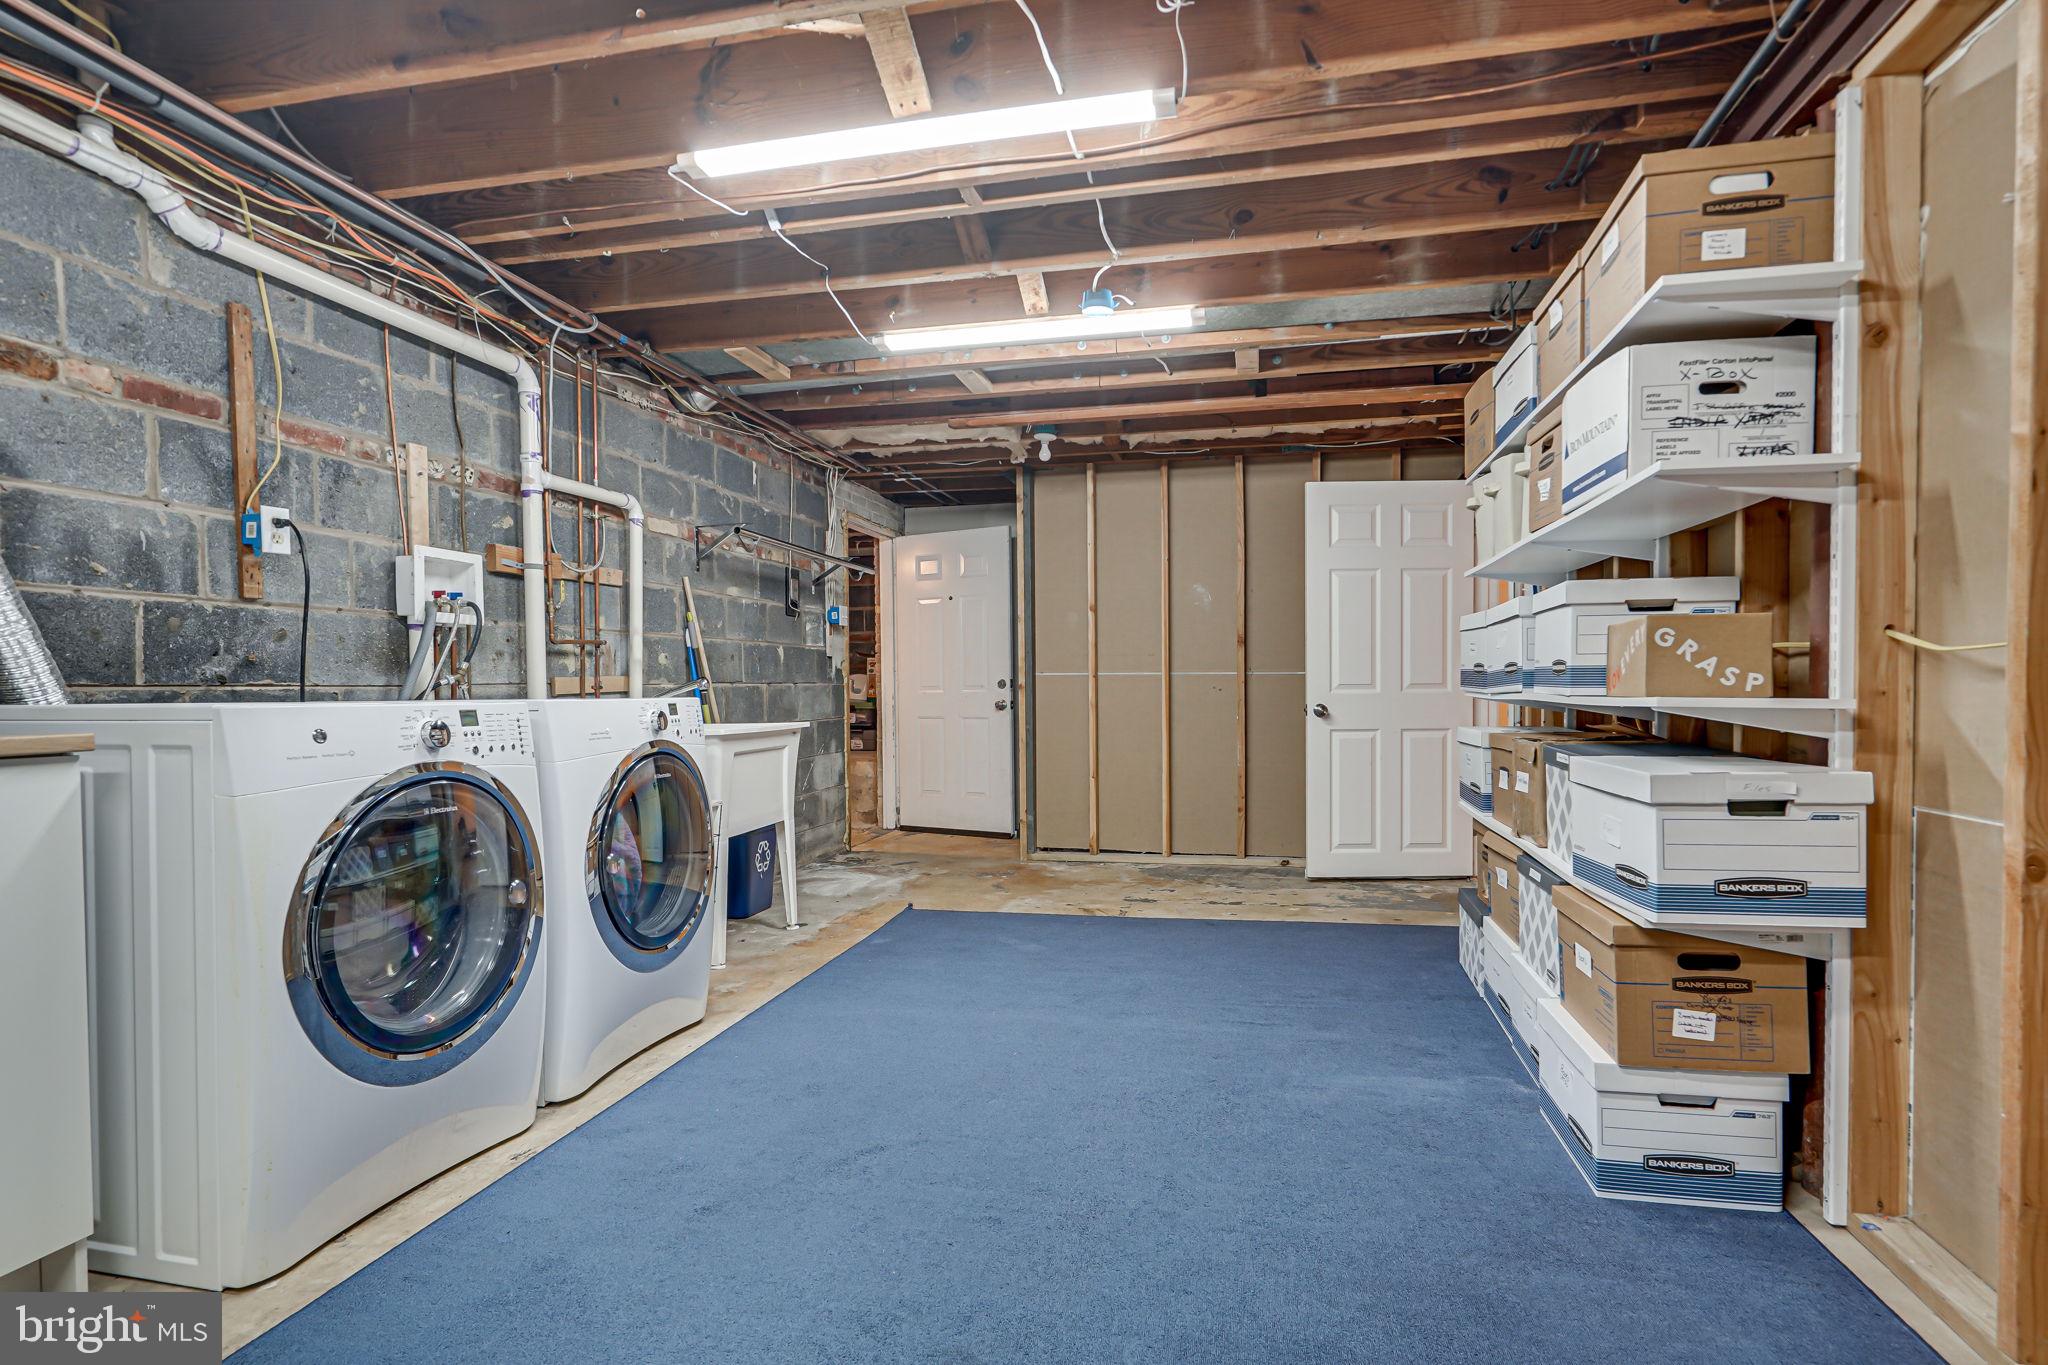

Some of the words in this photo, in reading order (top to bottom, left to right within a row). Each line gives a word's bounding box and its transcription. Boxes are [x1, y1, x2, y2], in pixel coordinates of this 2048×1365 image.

[1706, 201, 1757, 213] BANKERS
[1758, 199, 1782, 207] BOX
[1654, 627, 1765, 692] GRASP
[1719, 884, 1776, 892] BANKERS
[1676, 981, 1726, 989] BANKERS
[1648, 1159, 1704, 1169] BANKERS
[1705, 1163, 1730, 1172] BOX
